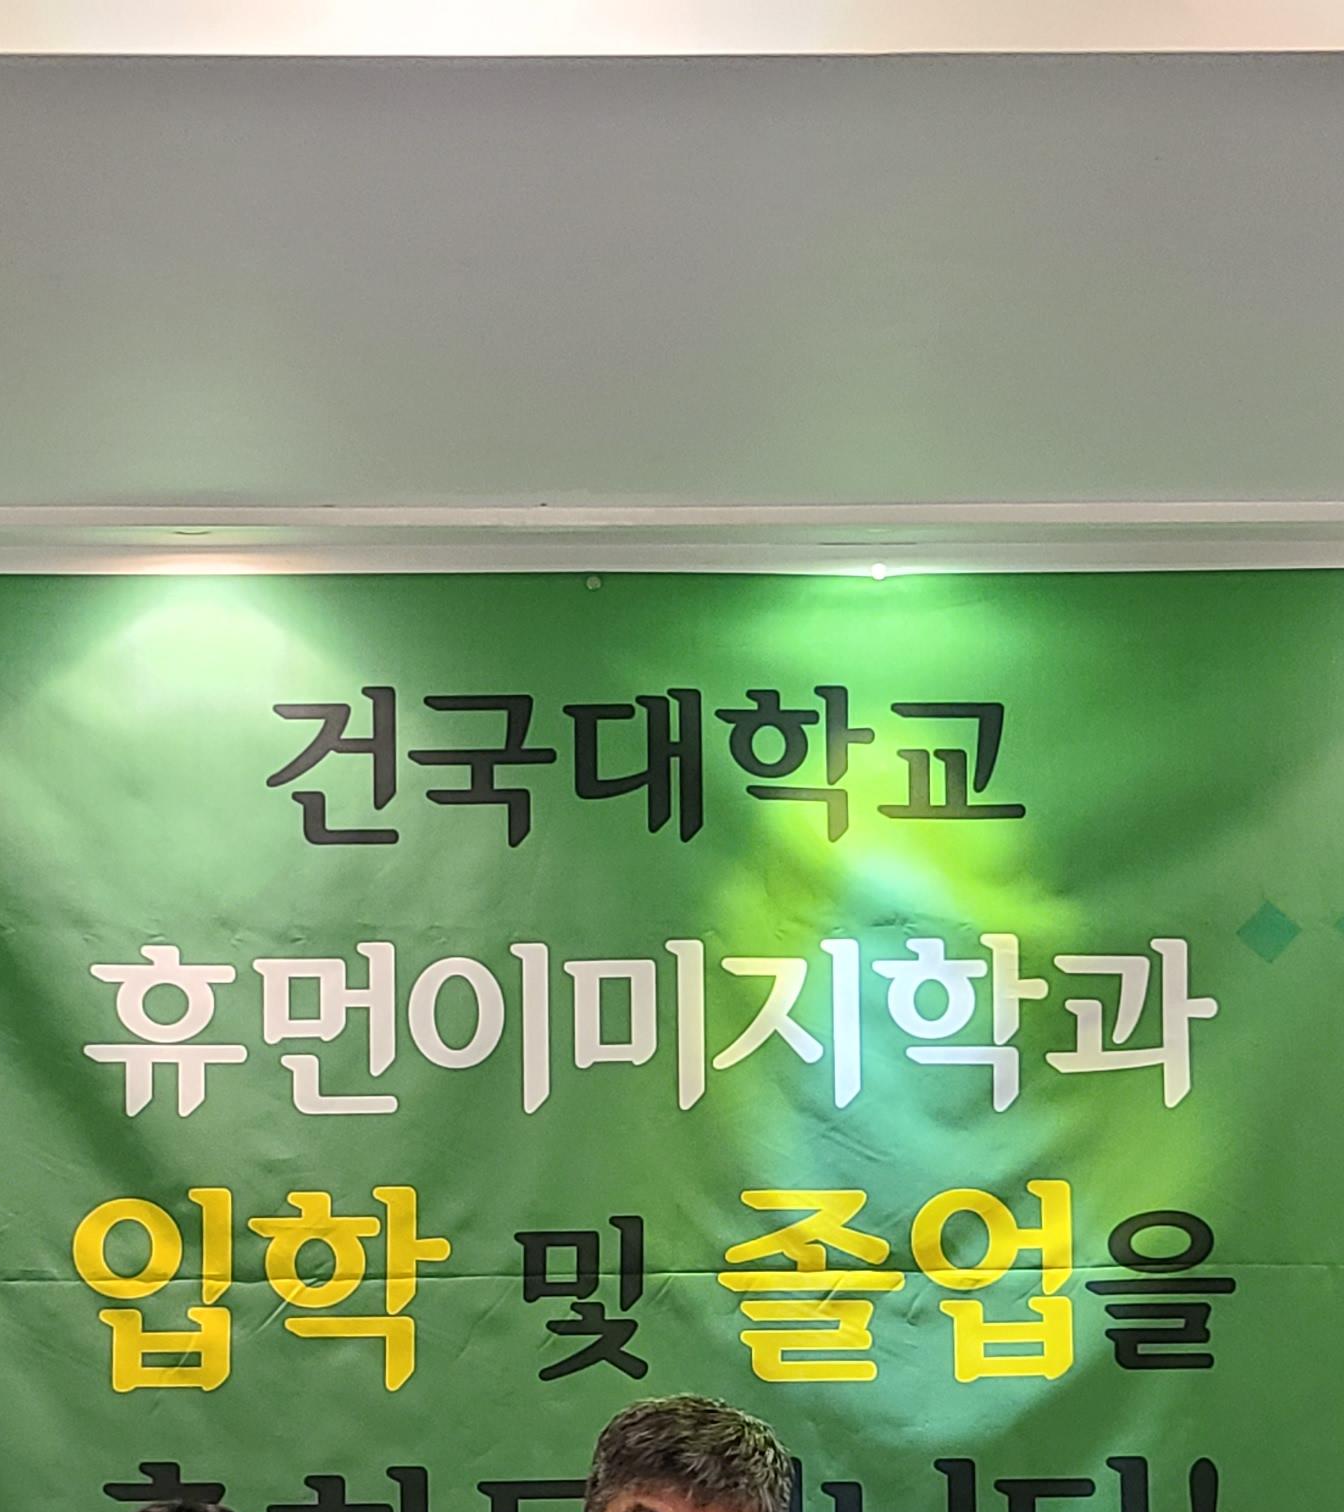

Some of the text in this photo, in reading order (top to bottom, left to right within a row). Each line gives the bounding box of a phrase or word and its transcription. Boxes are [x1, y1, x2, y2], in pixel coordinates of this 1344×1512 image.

[267, 684, 1026, 848] 건국대학교
[83, 933, 1219, 1116] 휴먼이미지학과
[72, 1179, 1237, 1393] 입학 및 졸업을
